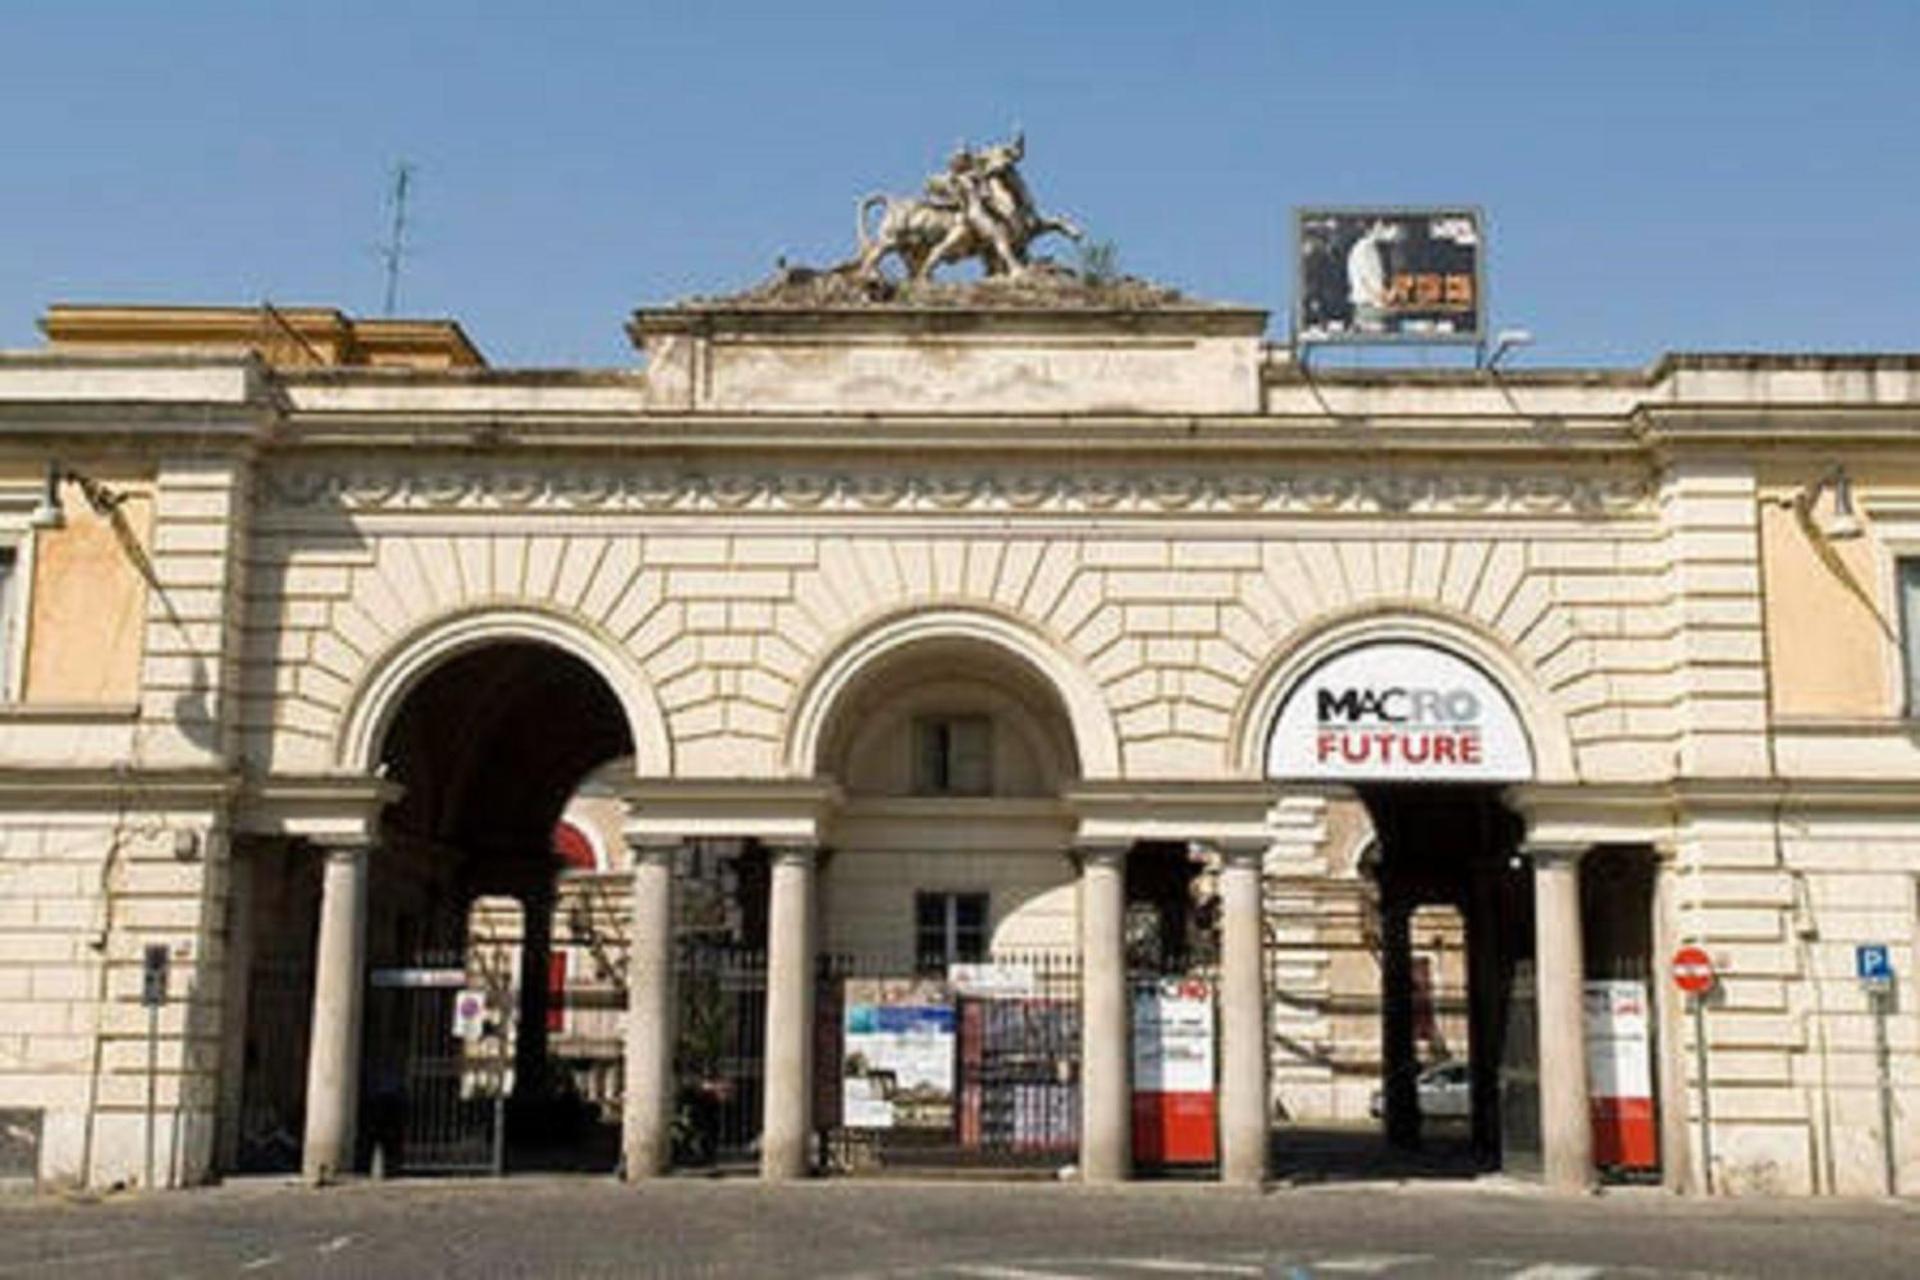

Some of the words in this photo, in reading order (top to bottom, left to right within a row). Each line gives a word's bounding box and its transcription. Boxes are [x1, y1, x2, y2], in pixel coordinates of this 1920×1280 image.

[1317, 688, 1481, 722] MACRO
[1317, 733, 1482, 764] FUTURE
[1864, 949, 1882, 975] P
